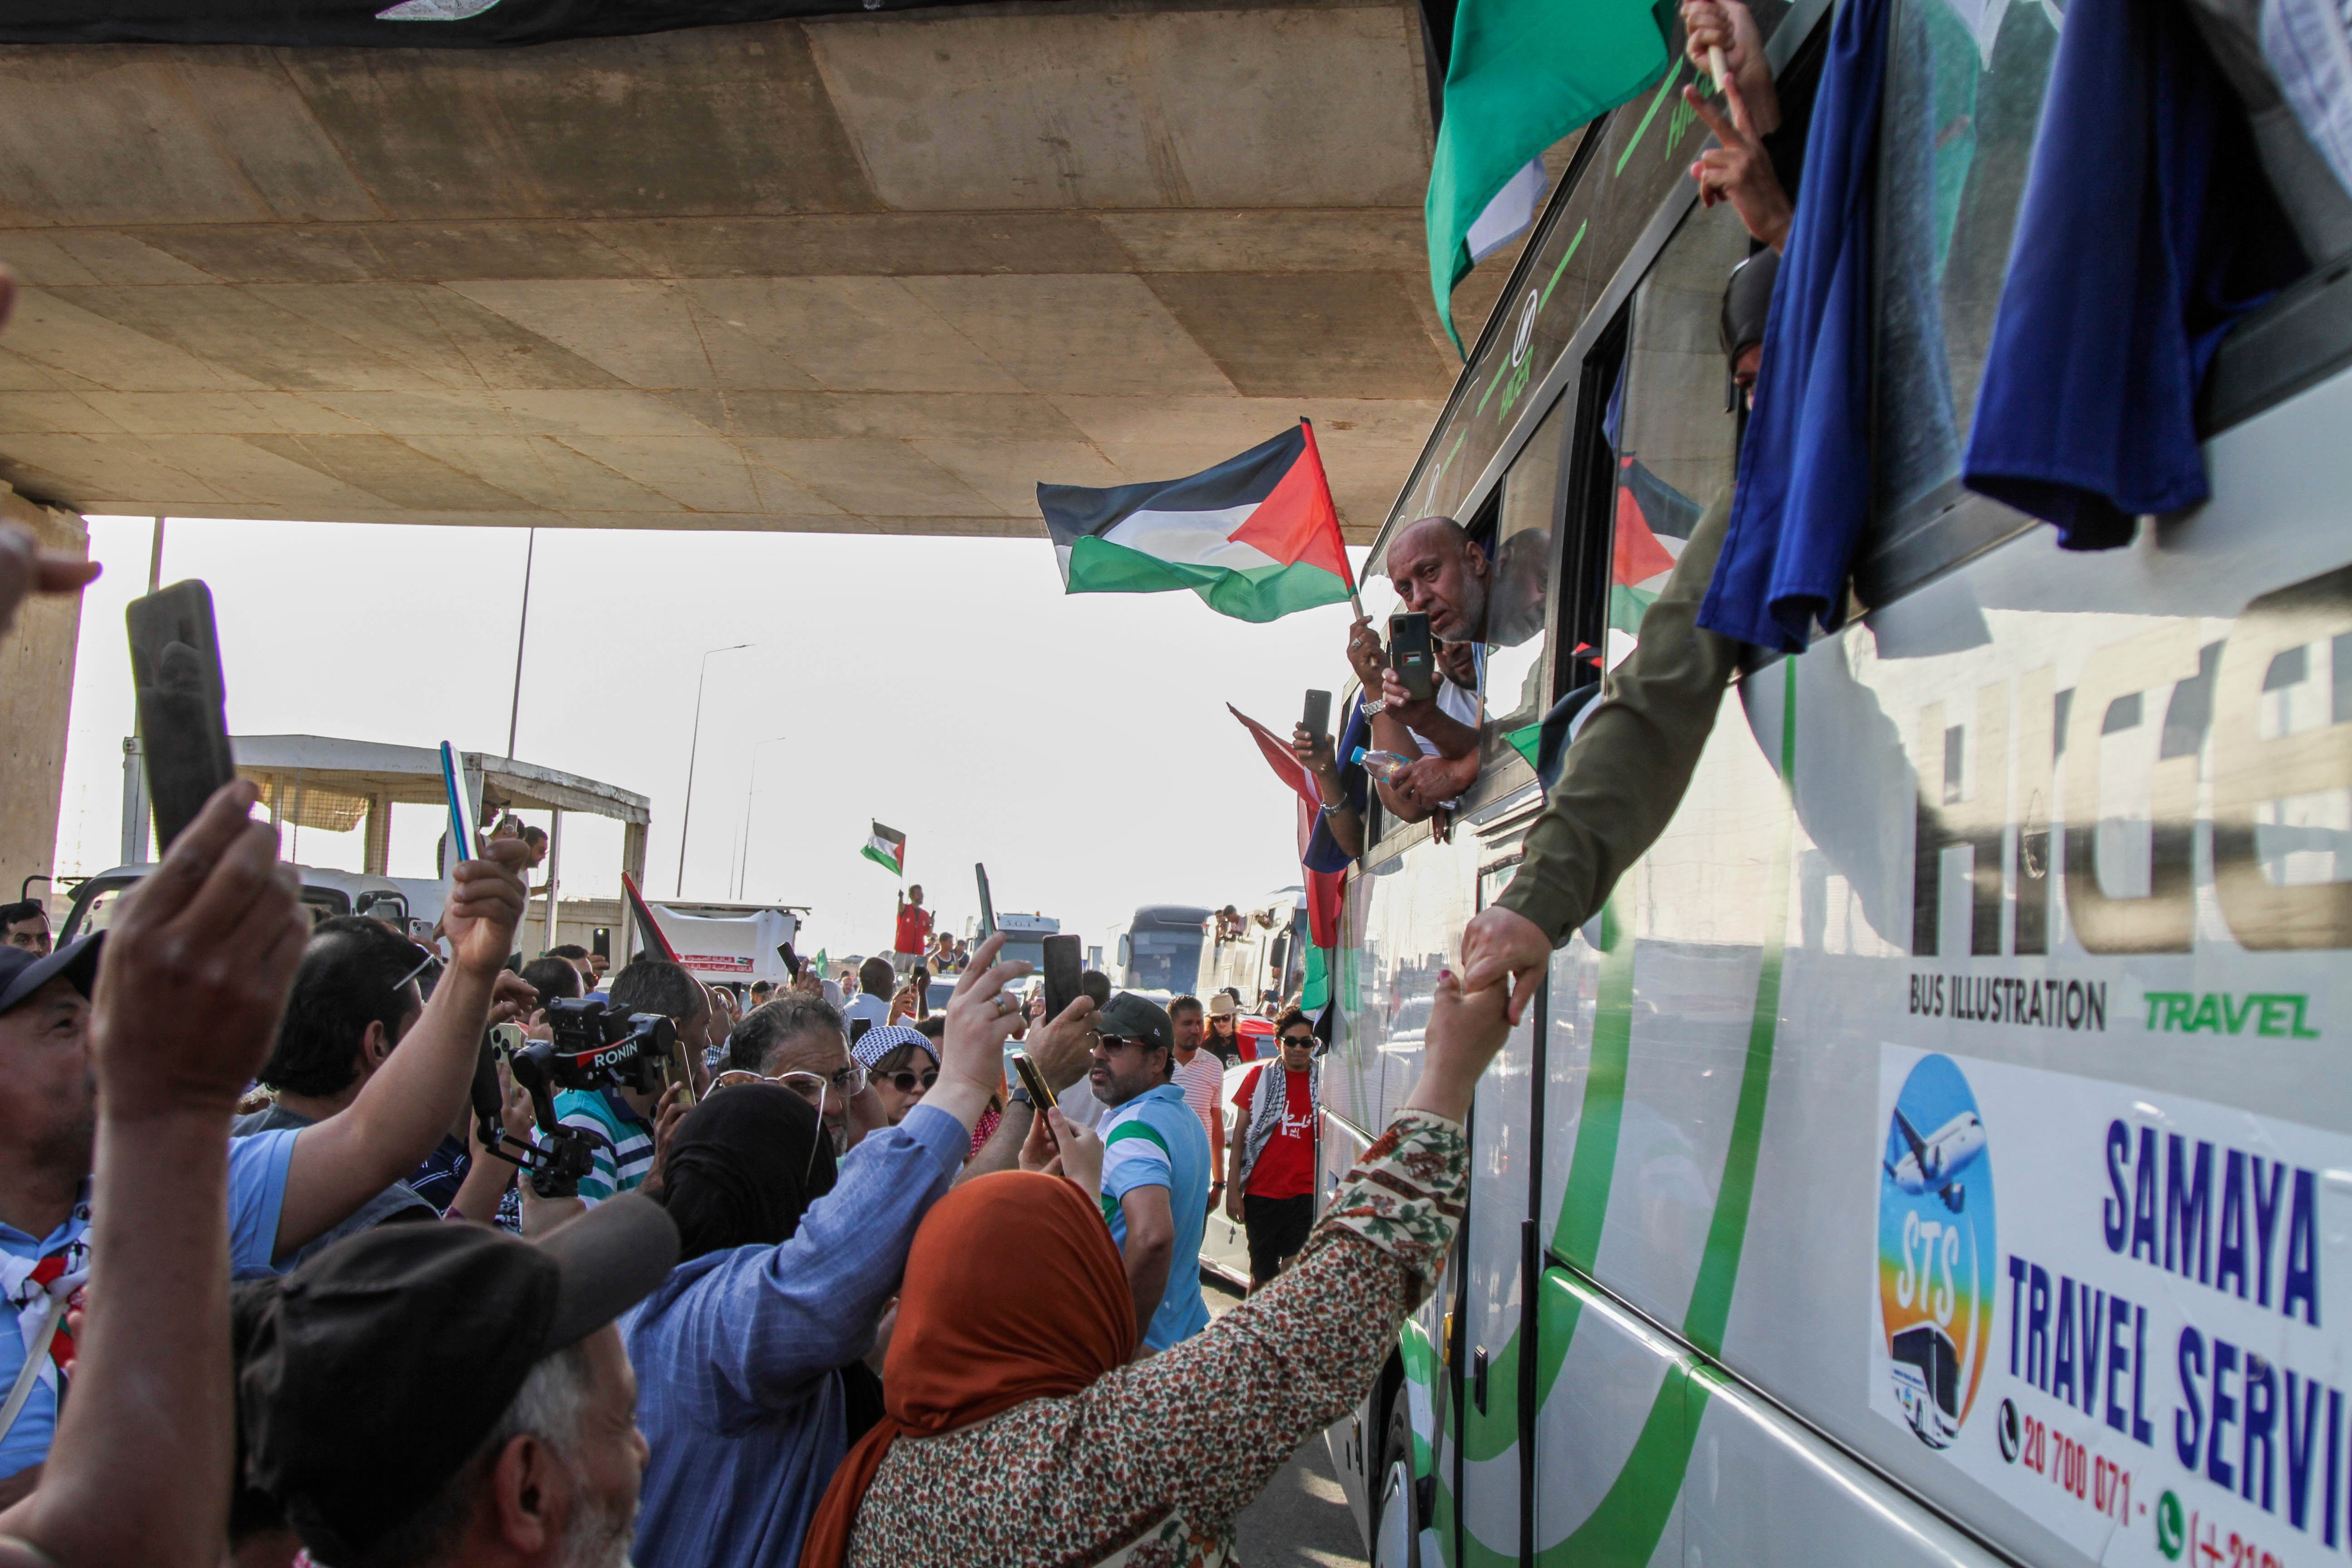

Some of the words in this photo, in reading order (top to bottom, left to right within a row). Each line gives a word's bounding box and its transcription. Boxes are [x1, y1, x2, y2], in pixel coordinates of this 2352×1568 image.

[594, 1040, 637, 1068] RONIN
[1909, 974, 1945, 1017] BUS
[1950, 975, 2107, 1032] ILLUSTRATION
[2143, 992, 2320, 1040] TRAVEL
[1897, 1210, 1959, 1328] STS
[2103, 1119, 2320, 1328] SAMAYA
[2009, 1255, 2155, 1448] TRAVEL
[2175, 1326, 2352, 1552] SERVI
[2024, 1414, 2046, 1475] 20
[2052, 1429, 2087, 1500] 700
[2095, 1455, 2130, 1527] 071
